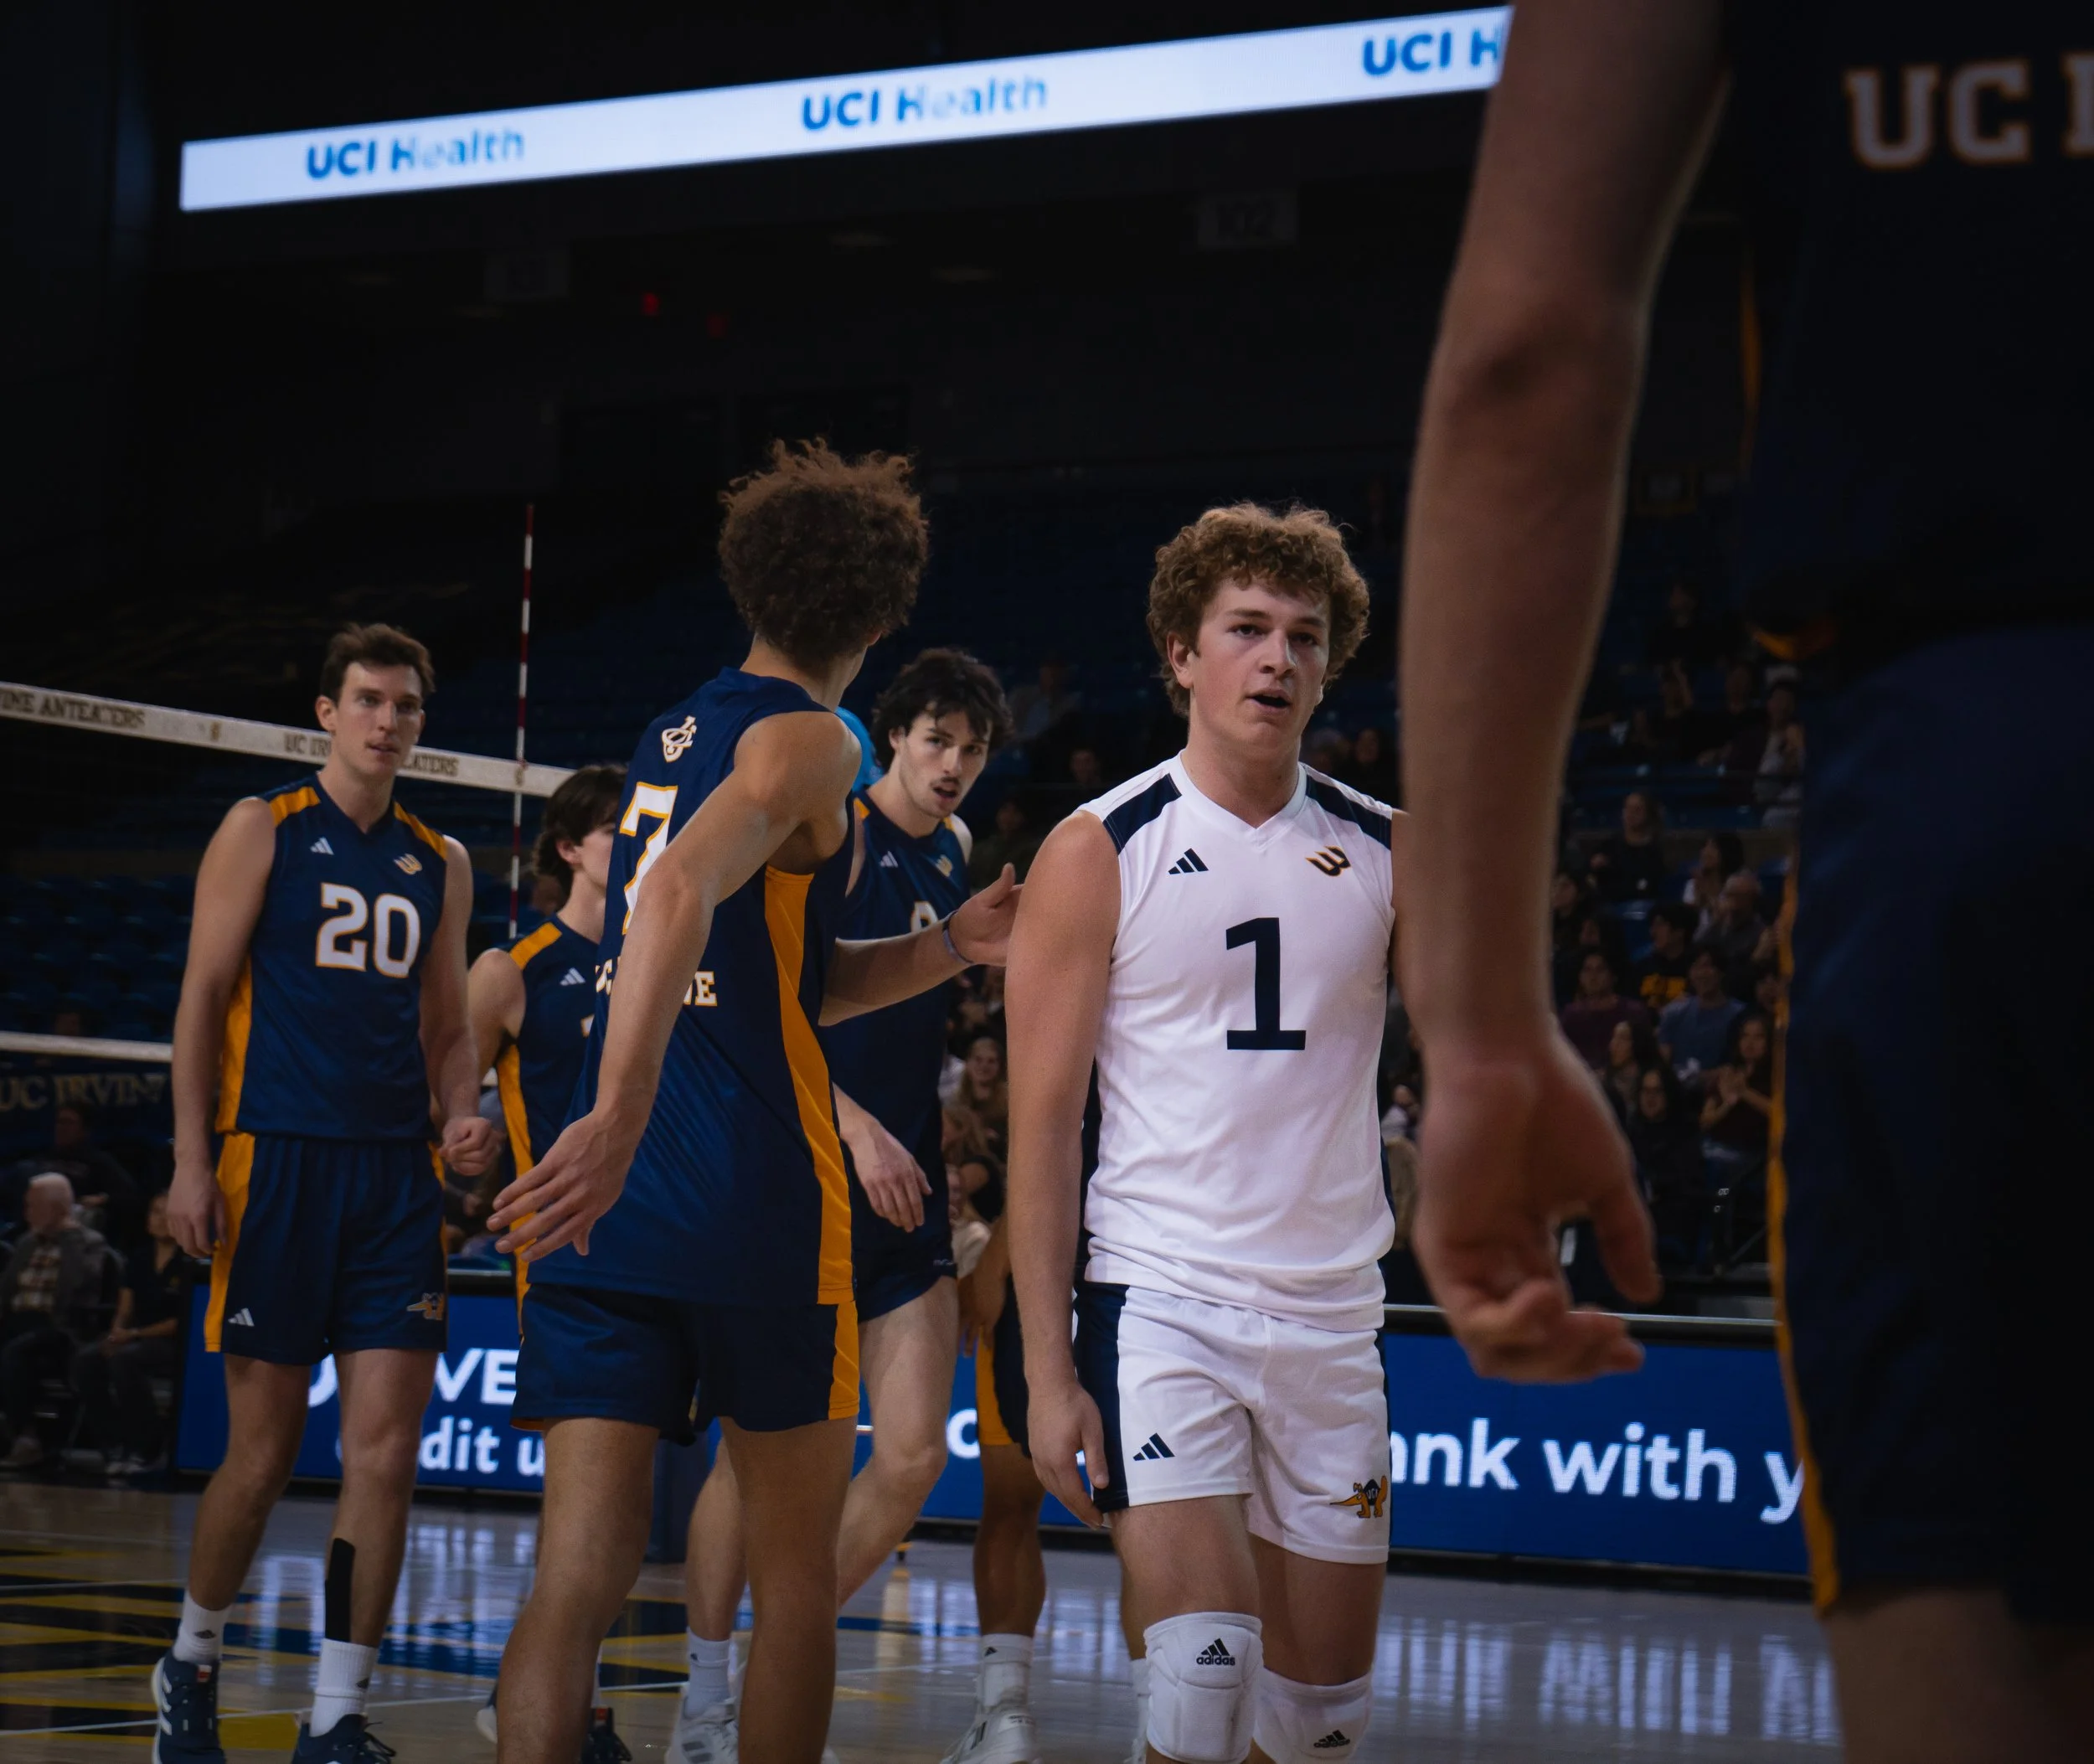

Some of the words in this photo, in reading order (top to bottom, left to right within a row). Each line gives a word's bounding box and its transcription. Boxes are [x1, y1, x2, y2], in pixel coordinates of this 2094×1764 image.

[1364, 31, 1452, 76] UCI
[803, 90, 879, 130] UCI
[1842, 56, 2032, 173] UC
[307, 140, 375, 179] UCI
[619, 781, 678, 936] 7
[315, 881, 421, 979] 20
[1225, 917, 1307, 1050] 1
[52, 1070, 168, 1107] IRVIN
[1542, 1421, 1737, 1504] with
[1196, 1655, 1235, 1666] adidas
